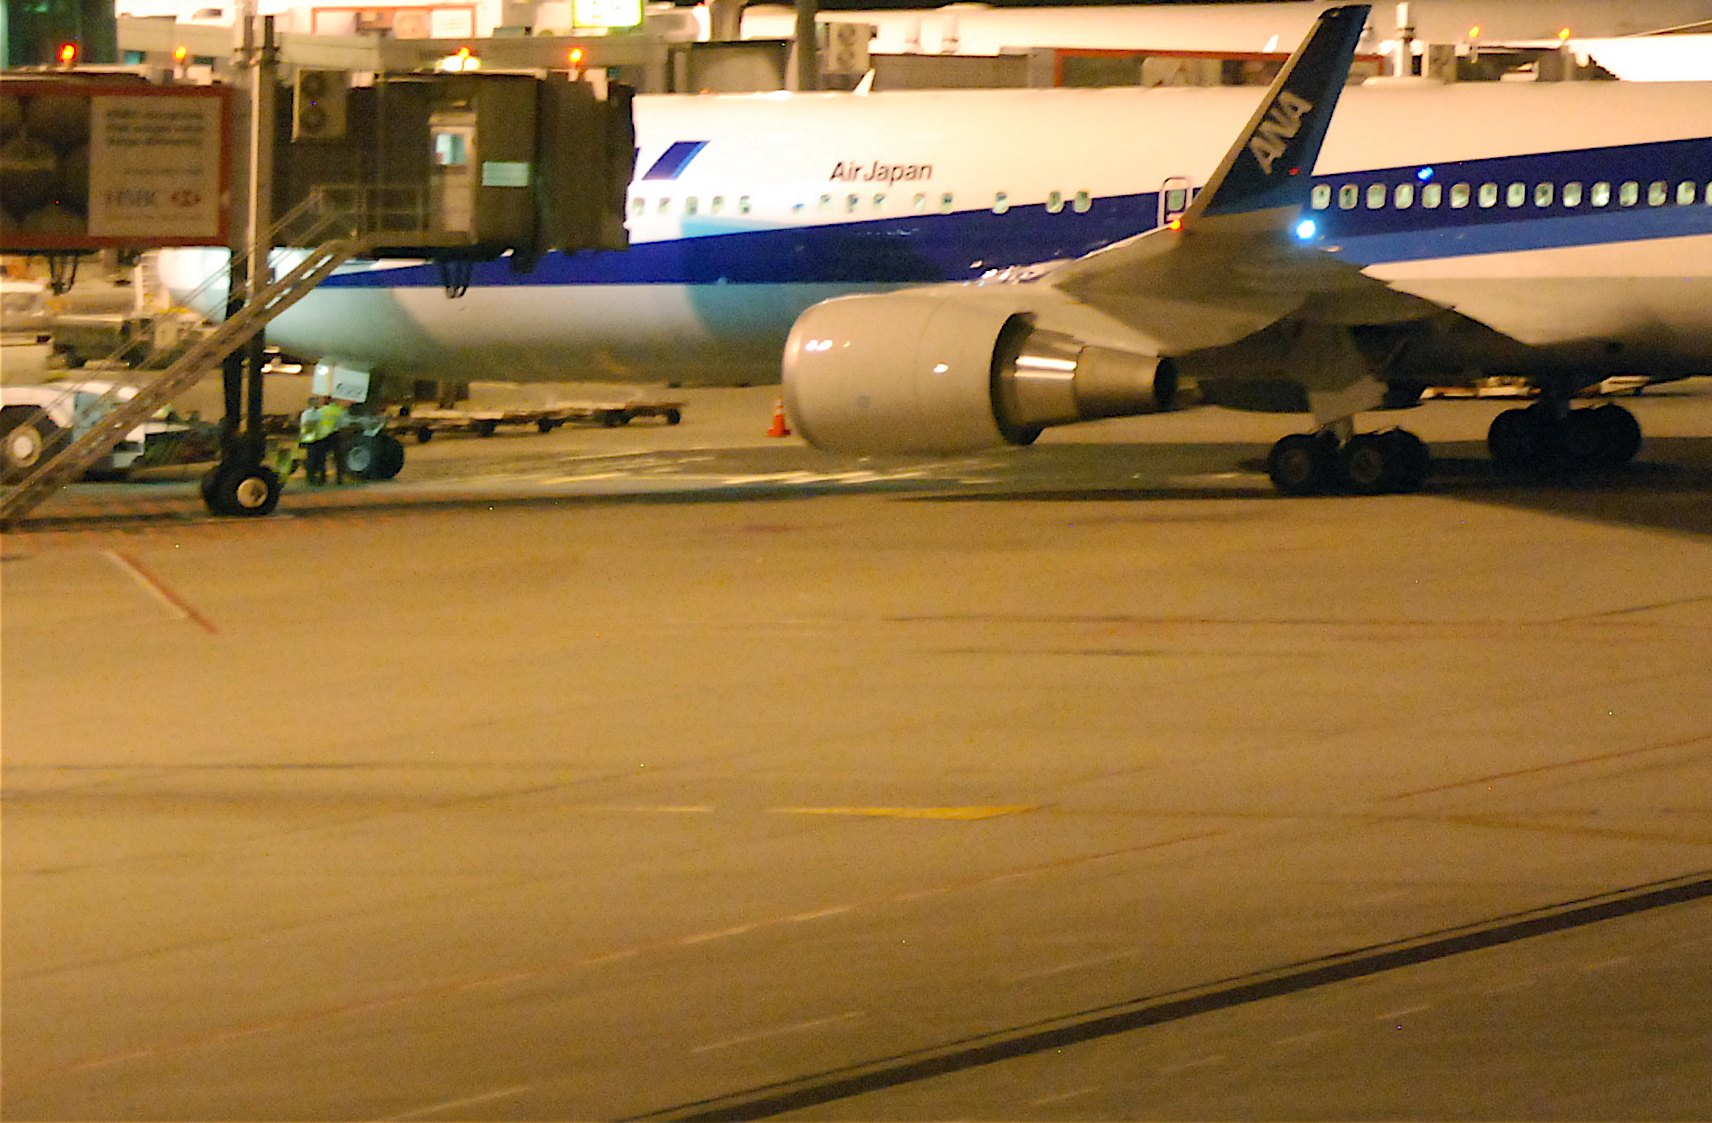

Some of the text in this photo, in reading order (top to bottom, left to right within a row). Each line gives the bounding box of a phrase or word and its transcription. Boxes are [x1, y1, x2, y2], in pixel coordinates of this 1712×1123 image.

[1250, 91, 1314, 175] ANA
[829, 160, 934, 187] Air Japan
